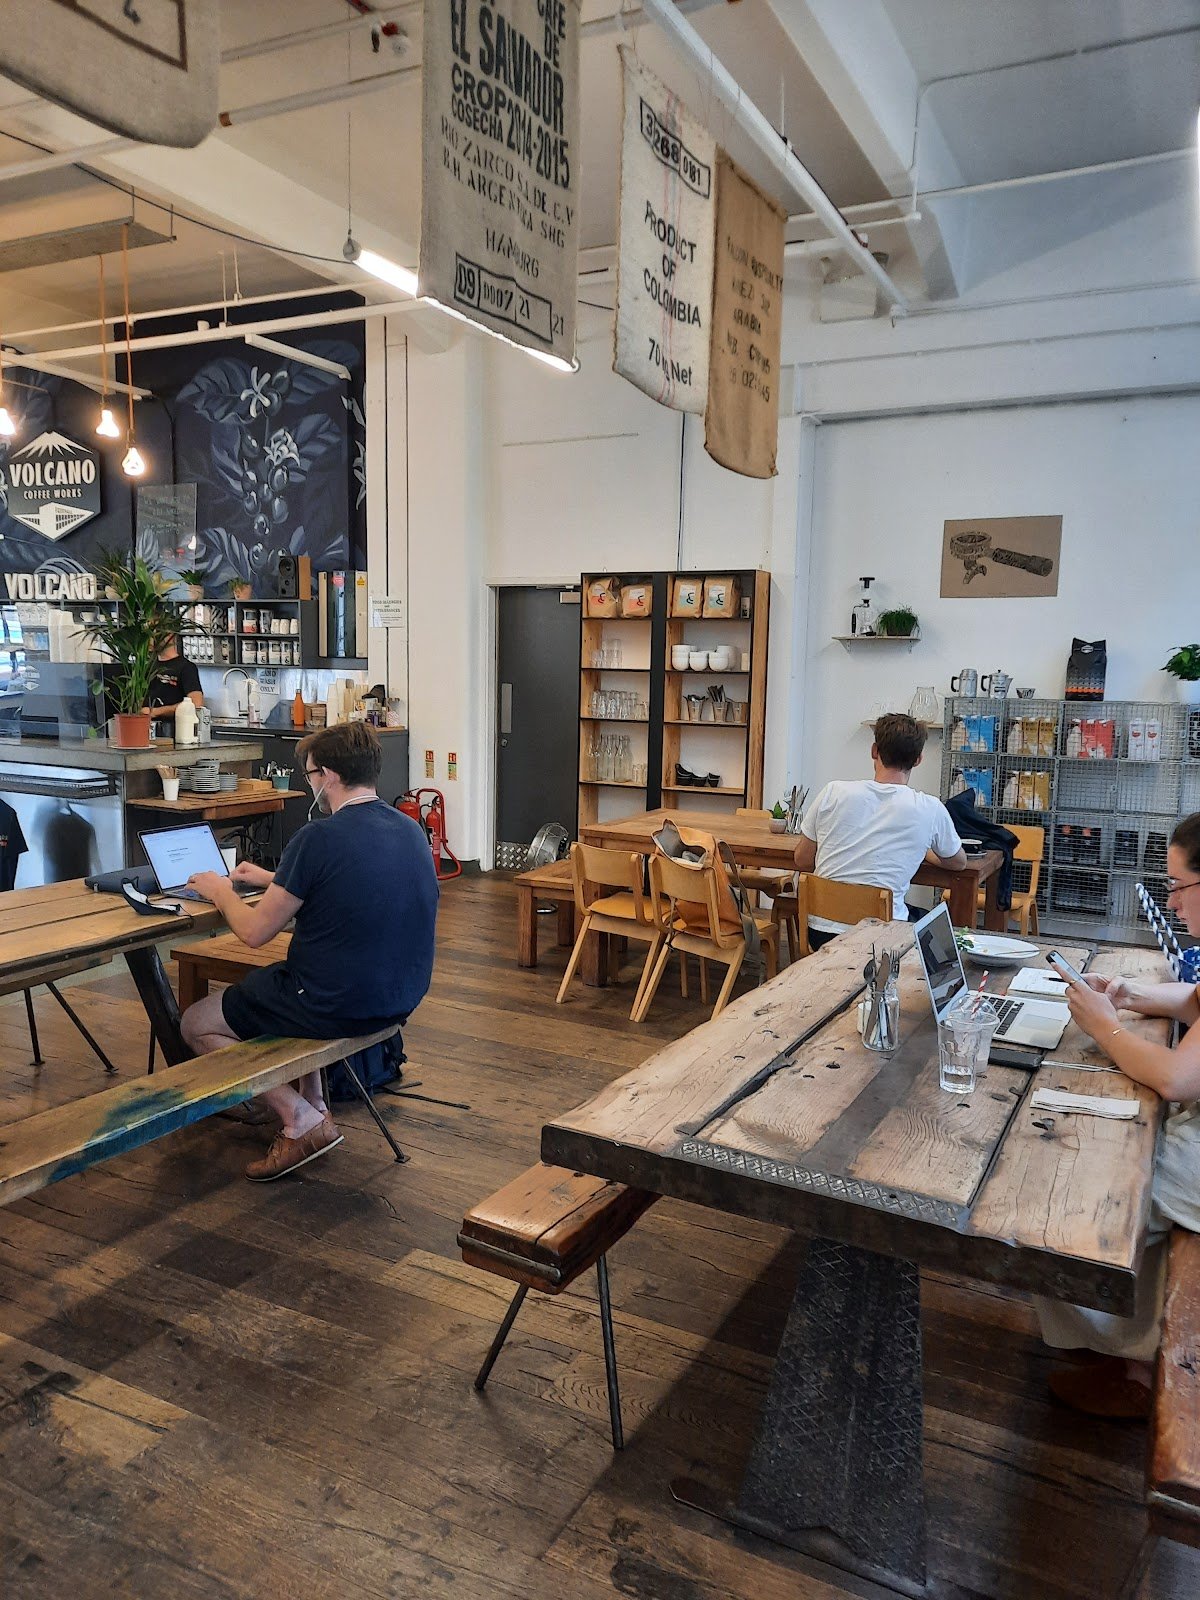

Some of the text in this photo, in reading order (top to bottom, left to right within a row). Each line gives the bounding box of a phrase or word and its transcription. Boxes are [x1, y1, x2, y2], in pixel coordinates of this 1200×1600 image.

[451, 0, 564, 136] EL SALVADOR
[451, 62, 507, 117] CROP
[451, 93, 504, 144] COSECHA
[644, 200, 697, 264] PRODUCT
[662, 253, 677, 282] OF
[643, 267, 701, 327] COLOMBIA
[648, 337, 660, 368] 70
[670, 359, 692, 387] Net
[9, 459, 95, 487] VOLCANO
[23, 488, 82, 500] COFFEE WORKS
[4, 573, 97, 600] VOLCANO
